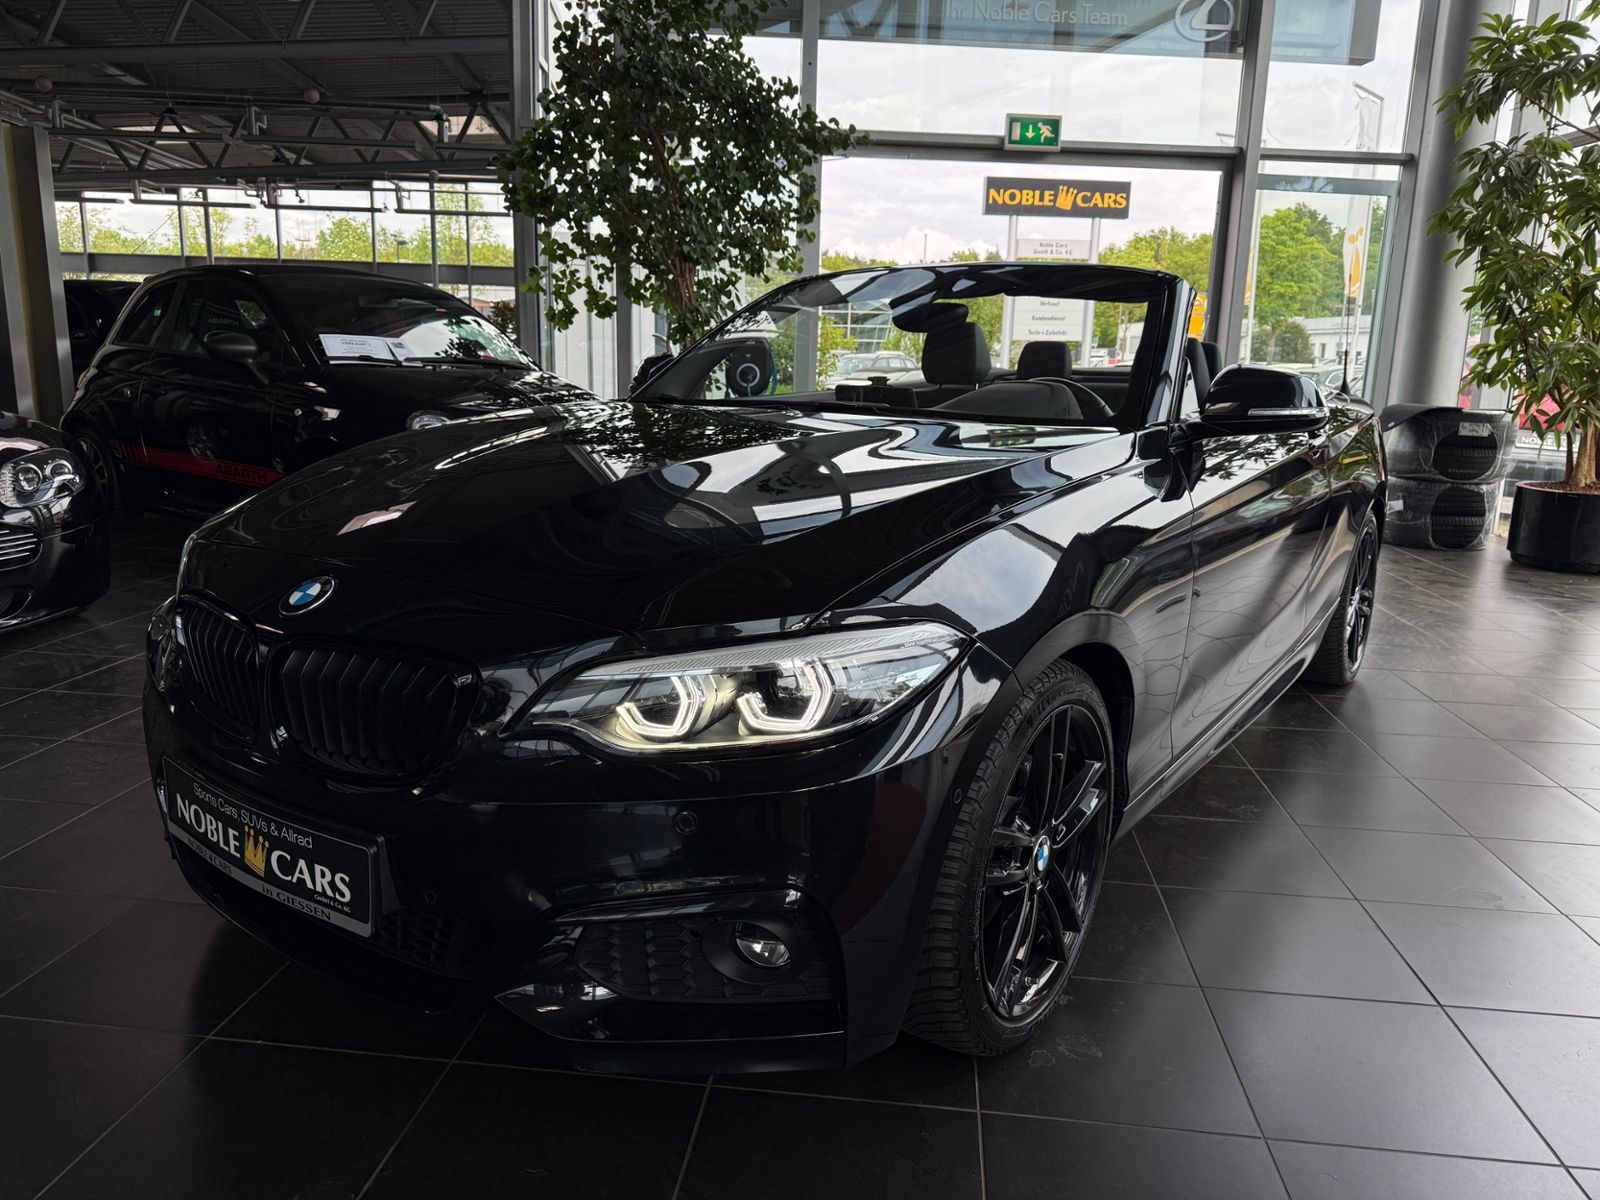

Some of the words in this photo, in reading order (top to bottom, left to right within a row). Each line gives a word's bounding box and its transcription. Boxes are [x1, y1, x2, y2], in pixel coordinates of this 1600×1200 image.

[945, 0, 966, 20] Ihr
[973, 0, 1029, 21] Noble
[1034, 2, 1077, 24] Cars
[1082, 4, 1128, 25] Team
[988, 188, 1055, 206] NOBLE
[1076, 191, 1127, 209] CARS
[215, 463, 267, 482] ABARTH
[193, 782, 217, 808] Sports
[241, 809, 268, 833] SUVs
[270, 823, 279, 836] &
[281, 826, 313, 849] Allrad
[176, 792, 241, 858] NOBLE
[270, 850, 351, 903] CARS
[261, 883, 274, 897] in
[276, 890, 331, 921] GIESSEN
